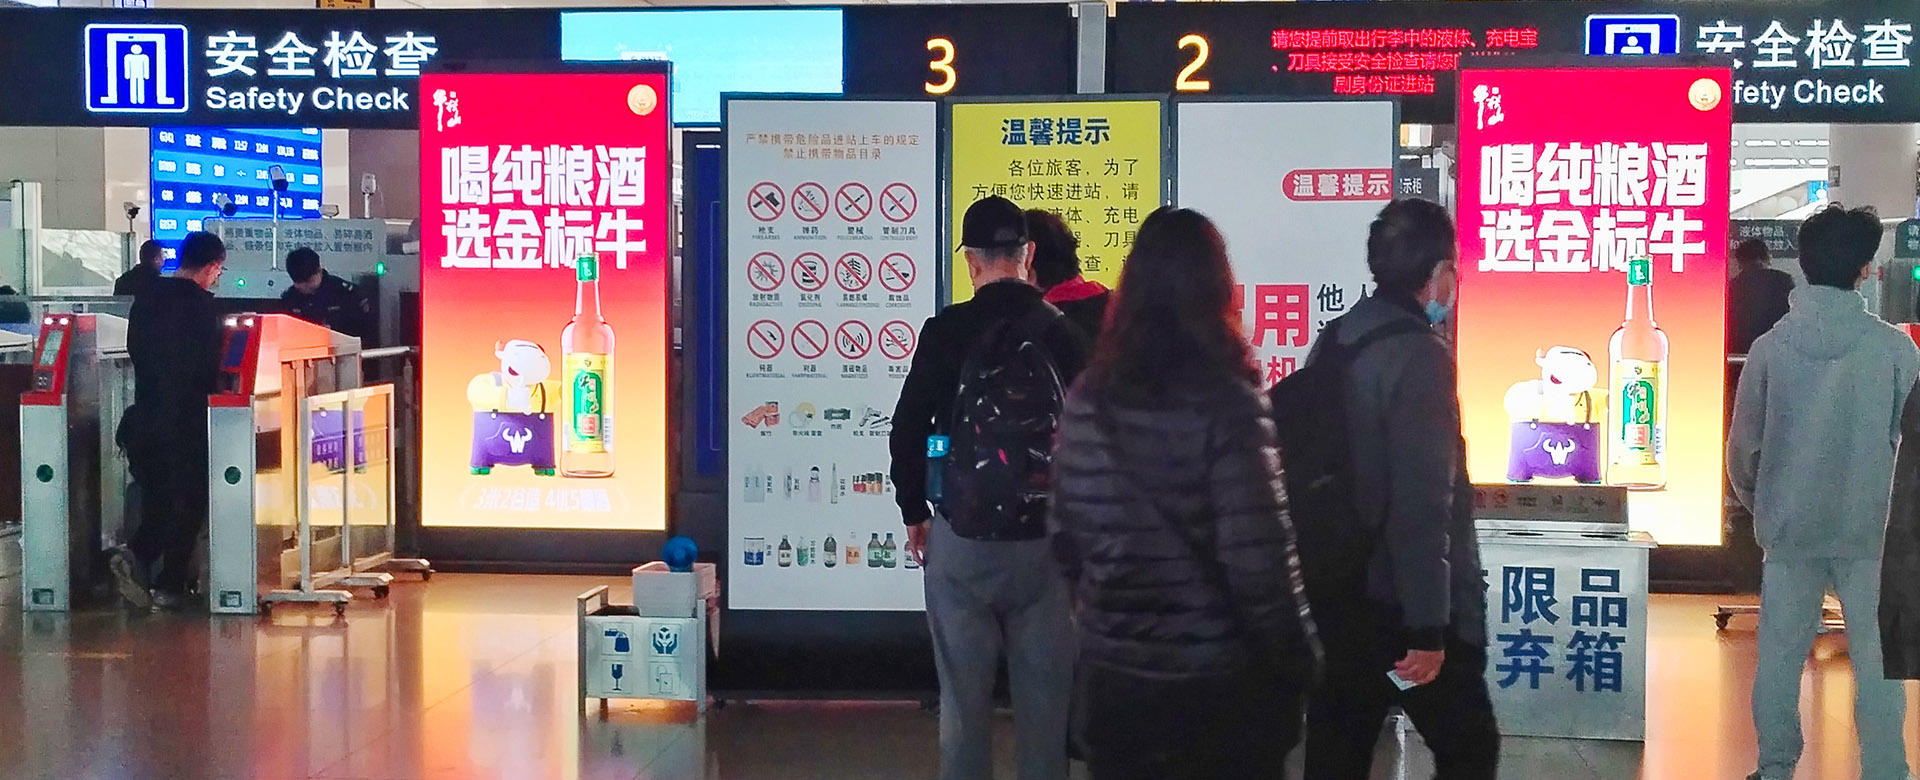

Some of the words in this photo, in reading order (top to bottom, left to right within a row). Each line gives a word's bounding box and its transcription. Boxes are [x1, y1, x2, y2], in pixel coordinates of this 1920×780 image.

[205, 31, 439, 78] 安全检查
[924, 37, 958, 94] 3
[1176, 34, 1211, 91] 2
[1271, 53, 1460, 71] 、刀具接受安全检查请您
[1696, 18, 1914, 70] 安全检查
[206, 88, 304, 114] Safety
[312, 88, 410, 110] Check
[1733, 80, 1786, 109] fety
[1793, 79, 1884, 104] Check
[746, 133, 920, 146] 严禁携带危险品进站上车的规定
[783, 148, 882, 160] 禁止携带物品目录
[1002, 118, 1110, 146] 温馨提示
[441, 144, 646, 206] 喝纯粮酒
[1292, 173, 1390, 197] 温馨提示
[1479, 141, 1708, 207] 喝纯粮酒
[441, 209, 646, 270] 选金标牛
[1479, 208, 1706, 273] 选金标牛
[1481, 566, 1627, 628] 限品
[1496, 628, 1626, 692] 弃箱
